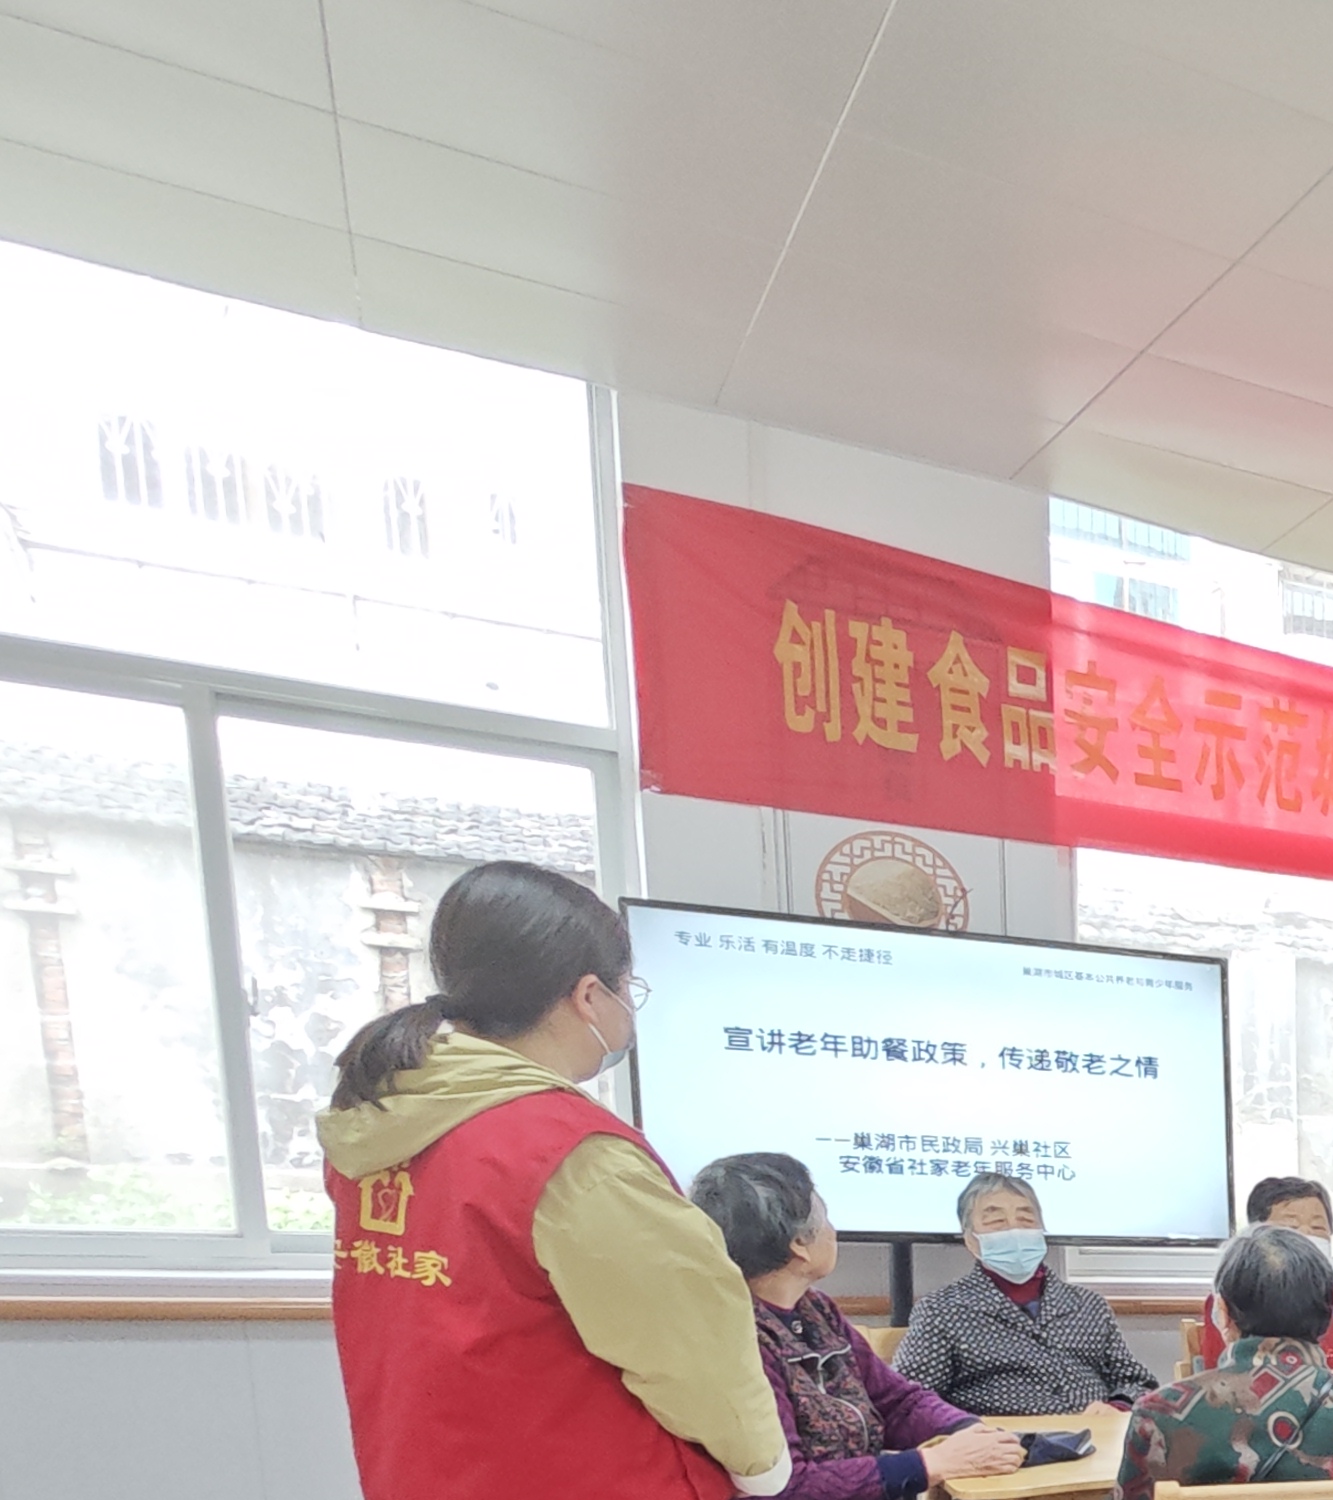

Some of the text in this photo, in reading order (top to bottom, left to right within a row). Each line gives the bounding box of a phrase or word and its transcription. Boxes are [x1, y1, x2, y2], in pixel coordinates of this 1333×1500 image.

[674, 929, 894, 966] 专业 乐活 有温度 不走捷径
[724, 1026, 1160, 1080] 宣讲老年助餐政策，传递敬老之情
[989, 1139, 1073, 1160] 兴巢社区
[838, 1154, 1077, 1182] 安徽省社家老年服务中心
